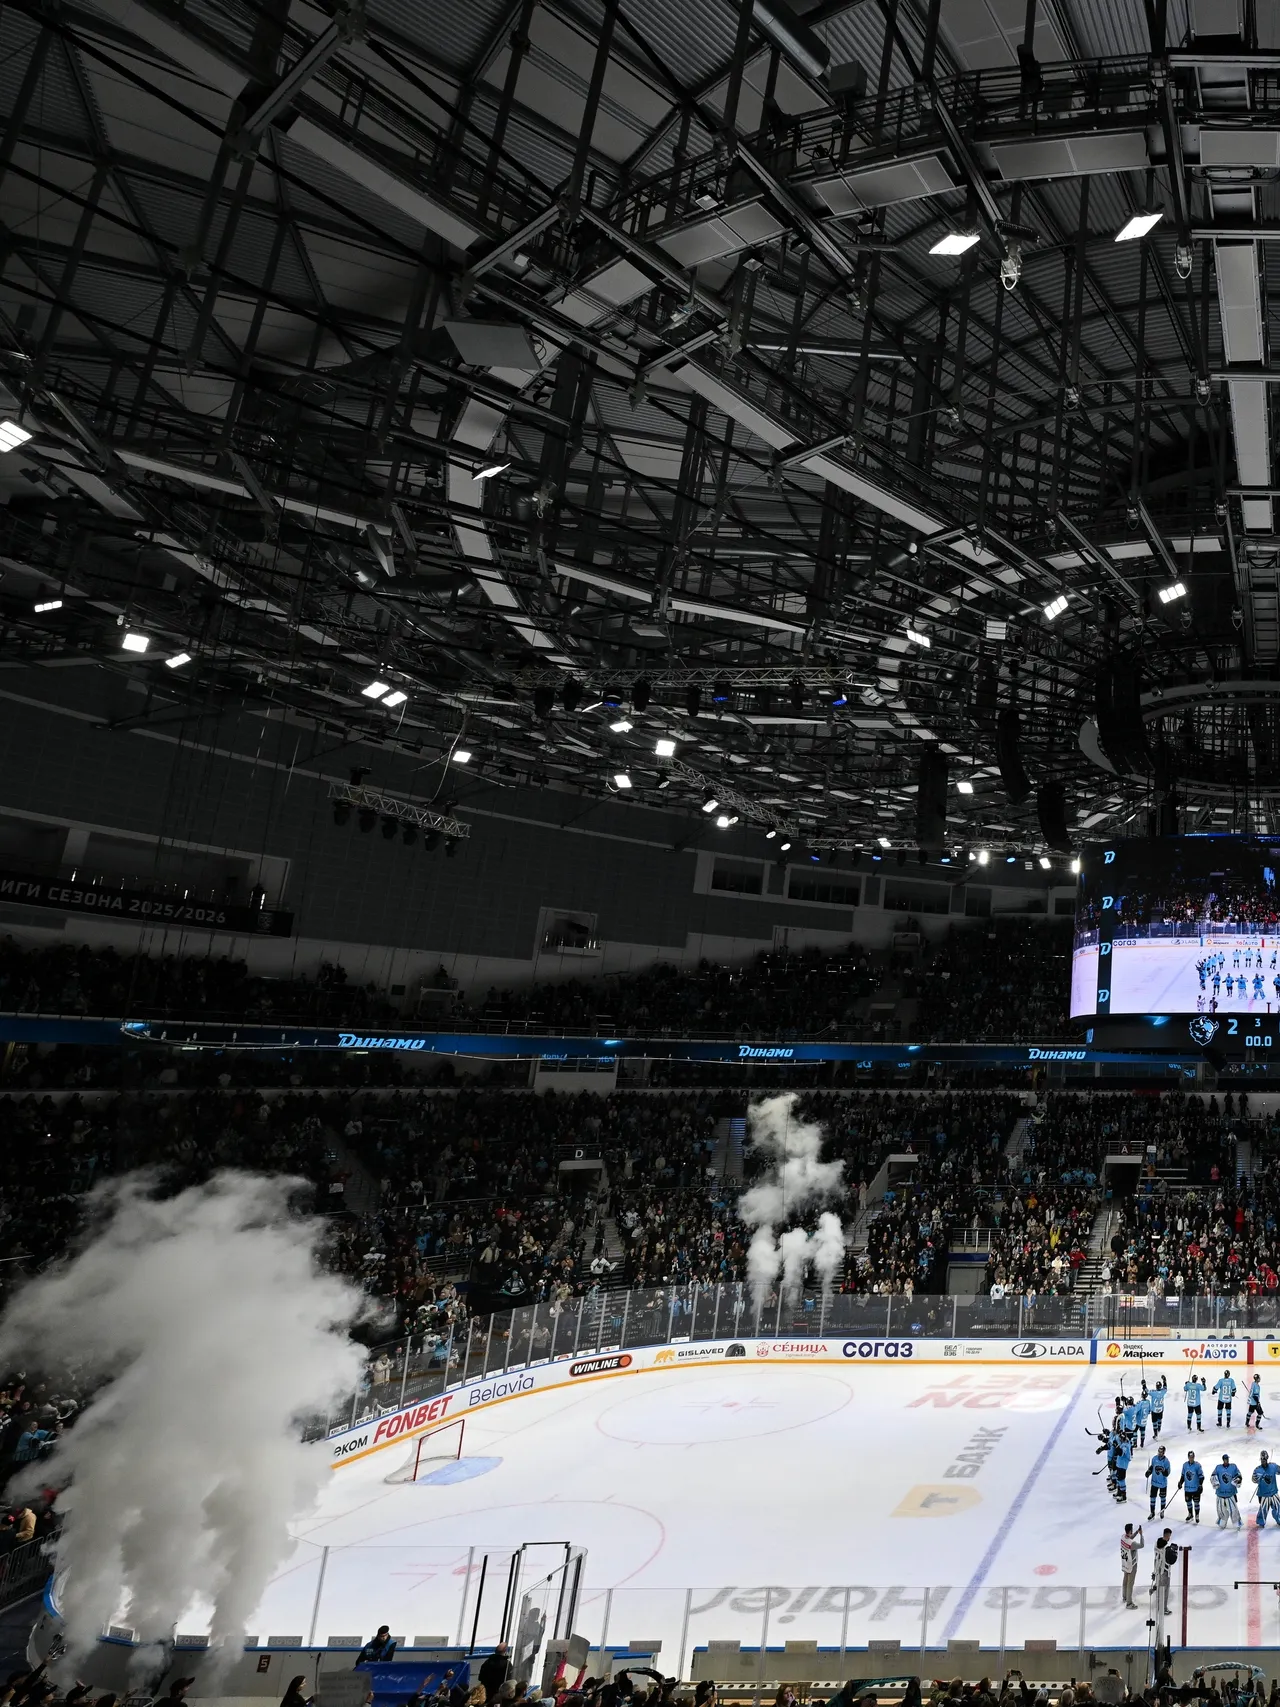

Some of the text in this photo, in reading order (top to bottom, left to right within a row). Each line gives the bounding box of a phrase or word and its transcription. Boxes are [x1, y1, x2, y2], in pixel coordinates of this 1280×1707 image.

[47, 887, 124, 910] СЕЗОНА
[129, 898, 226, 924] 2025/2026
[1227, 1019, 1238, 1035] 2
[1255, 1018, 1261, 1027] 3
[1245, 1036, 1272, 1047] 00.0
[678, 1347, 724, 1357] GISLAVED
[842, 1341, 913, 1358] согаз
[1050, 1346, 1085, 1356] LADA
[1122, 1350, 1164, 1359] Маркет
[573, 1357, 619, 1375] WINLINE
[469, 1373, 535, 1407] Belavia
[373, 1395, 454, 1444] FONBET
[942, 1426, 1010, 1478] БАНК
[687, 1585, 954, 1624] Haier
